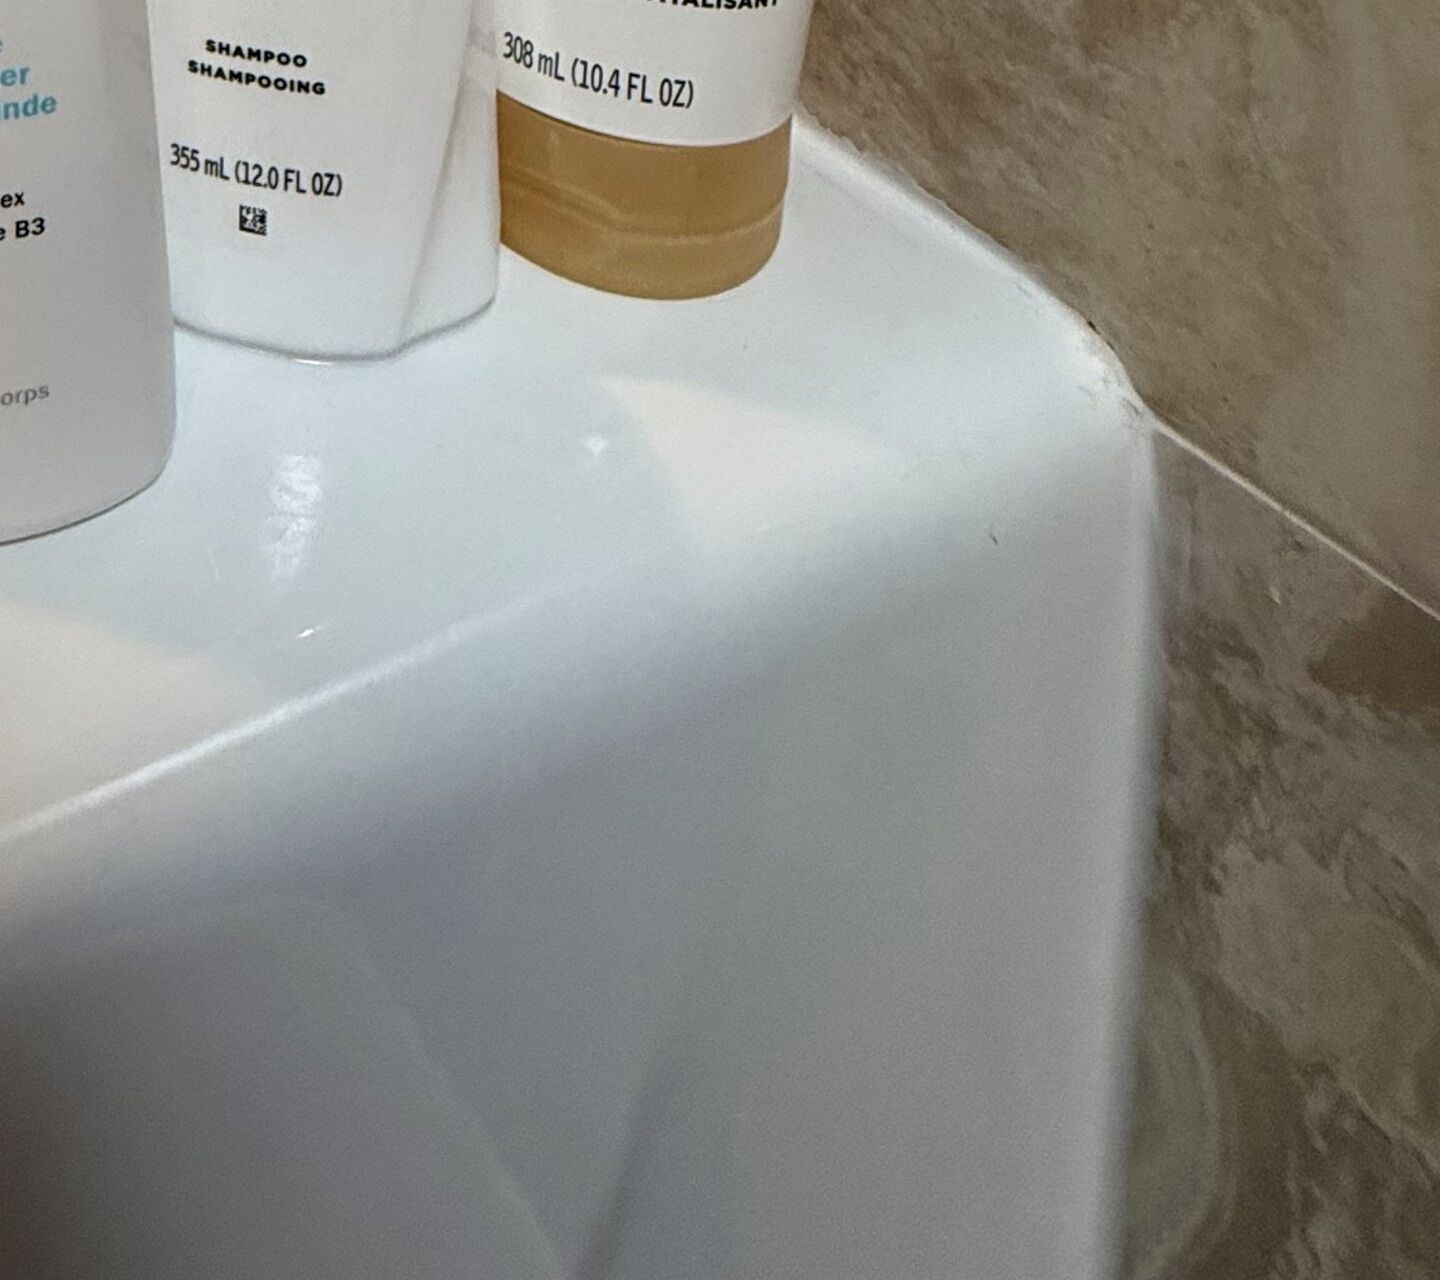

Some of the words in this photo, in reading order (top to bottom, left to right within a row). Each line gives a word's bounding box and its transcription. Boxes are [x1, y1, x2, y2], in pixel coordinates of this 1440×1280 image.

[205, 39, 307, 68] SHAMPOO
[502, 31, 534, 69] 308
[538, 51, 565, 82] mL
[571, 57, 621, 97] (10.4
[627, 71, 653, 104] FL
[659, 78, 694, 109] OZ)
[188, 60, 326, 95] SHAMPOOING
[170, 143, 200, 172] 355
[204, 157, 230, 180] mL
[235, 160, 279, 190] (12.0
[284, 169, 307, 194] FL
[312, 172, 342, 197] OZ)
[15, 217, 46, 239] B3
